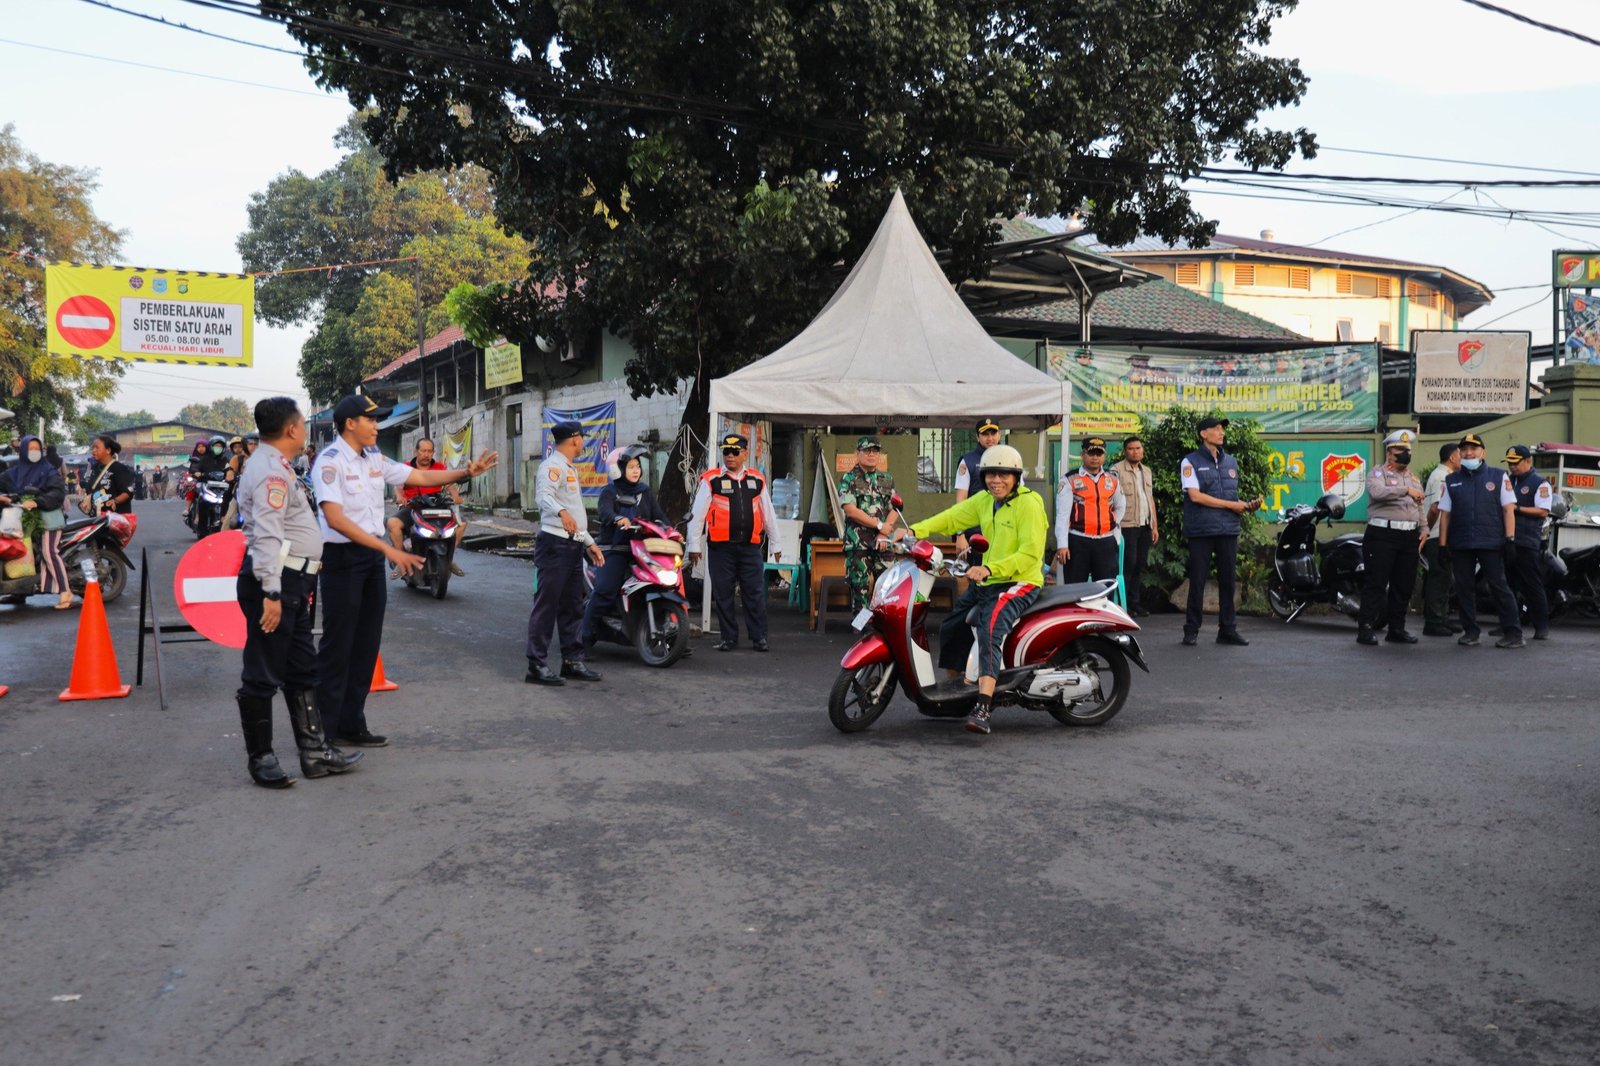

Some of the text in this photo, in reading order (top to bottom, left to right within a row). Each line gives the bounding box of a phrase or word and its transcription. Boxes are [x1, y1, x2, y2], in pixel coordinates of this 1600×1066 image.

[140, 302, 225, 319] PEMBERLAKUAN
[133, 318, 232, 336] SISTEM SATU ARAH
[145, 334, 169, 344] 05.00
[177, 336, 201, 345] 08.00
[203, 337, 220, 346] WIB
[140, 343, 225, 354] KECUALI HARI LIBUR
[1141, 375, 1173, 384] Telah
[1176, 375, 1222, 385] Dibuka
[1421, 377, 1444, 388] KOMANDO
[1444, 377, 1462, 388] DISTRIK
[1463, 377, 1481, 388] MILITER
[1493, 378, 1520, 389] TANGERANG
[1101, 383, 1342, 402] BINTARA PRAJURIT KARIER
[1427, 391, 1450, 401] KOMANDO
[1451, 391, 1467, 401] RAYON
[1467, 391, 1486, 402] MILITER
[1493, 392, 1513, 402] CIPUTAT
[1084, 401, 1104, 412] TNI
[1106, 401, 1169, 413] ANGKATAN
[1303, 400, 1317, 411] TA
[1320, 399, 1354, 411] 2025
[1267, 451, 1306, 478] 05
[1567, 473, 1595, 487] SUSU
